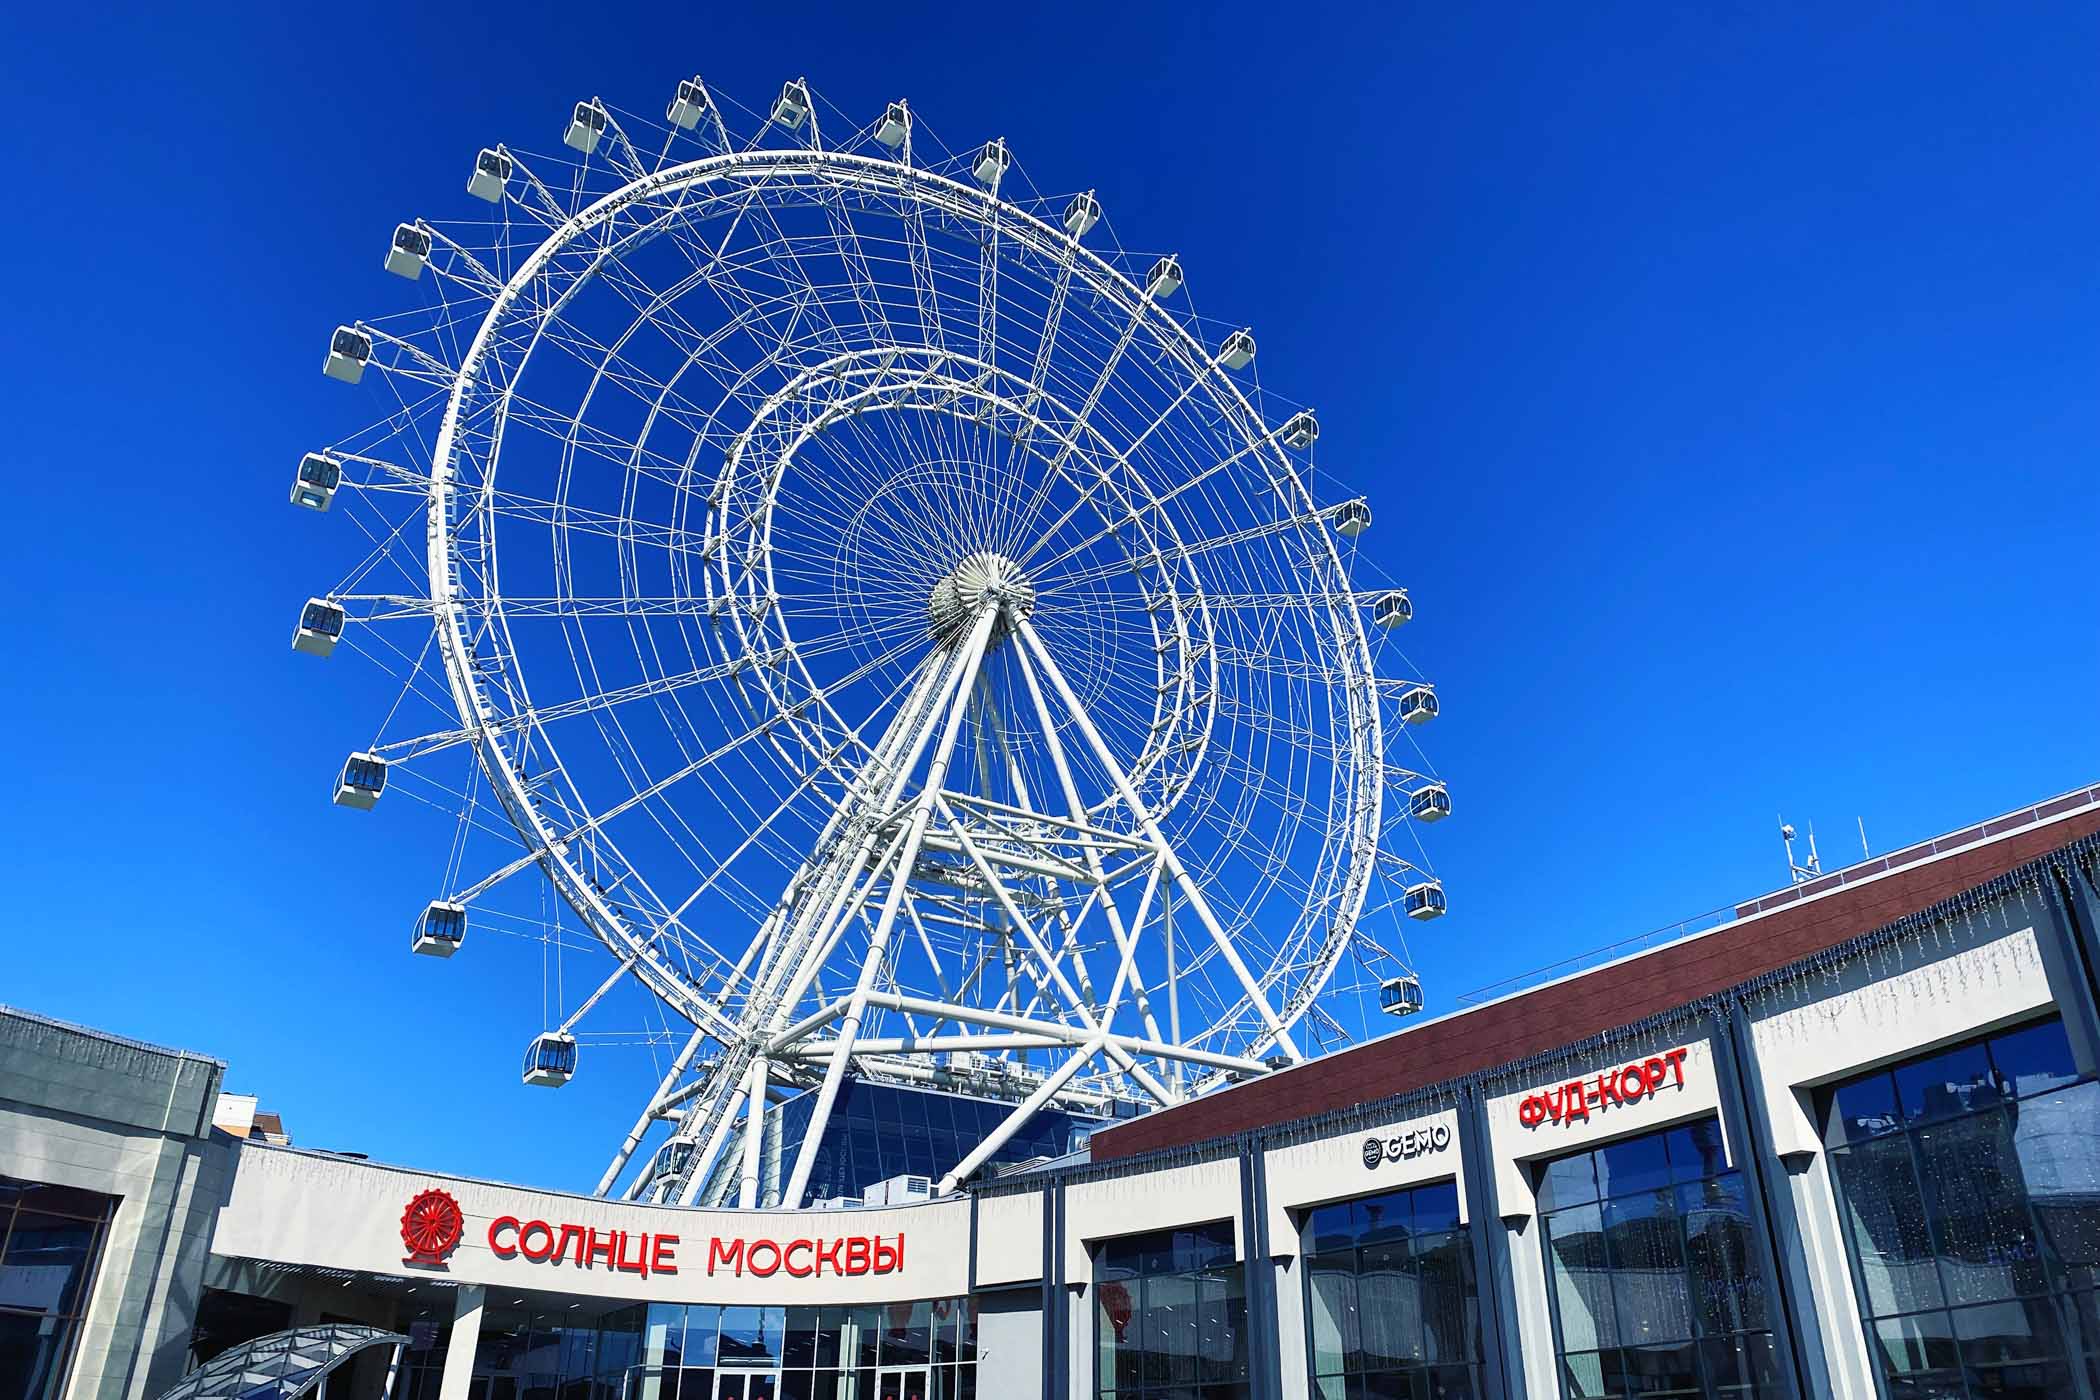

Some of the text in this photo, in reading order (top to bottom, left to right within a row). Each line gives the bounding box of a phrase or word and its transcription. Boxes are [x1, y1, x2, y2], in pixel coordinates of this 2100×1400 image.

[1520, 1048, 1687, 1126] ФУД-КОРТ
[1386, 1123, 1449, 1159] GEMO
[489, 1215, 905, 1278] СОЛНЦЕ МОСКВЫ
